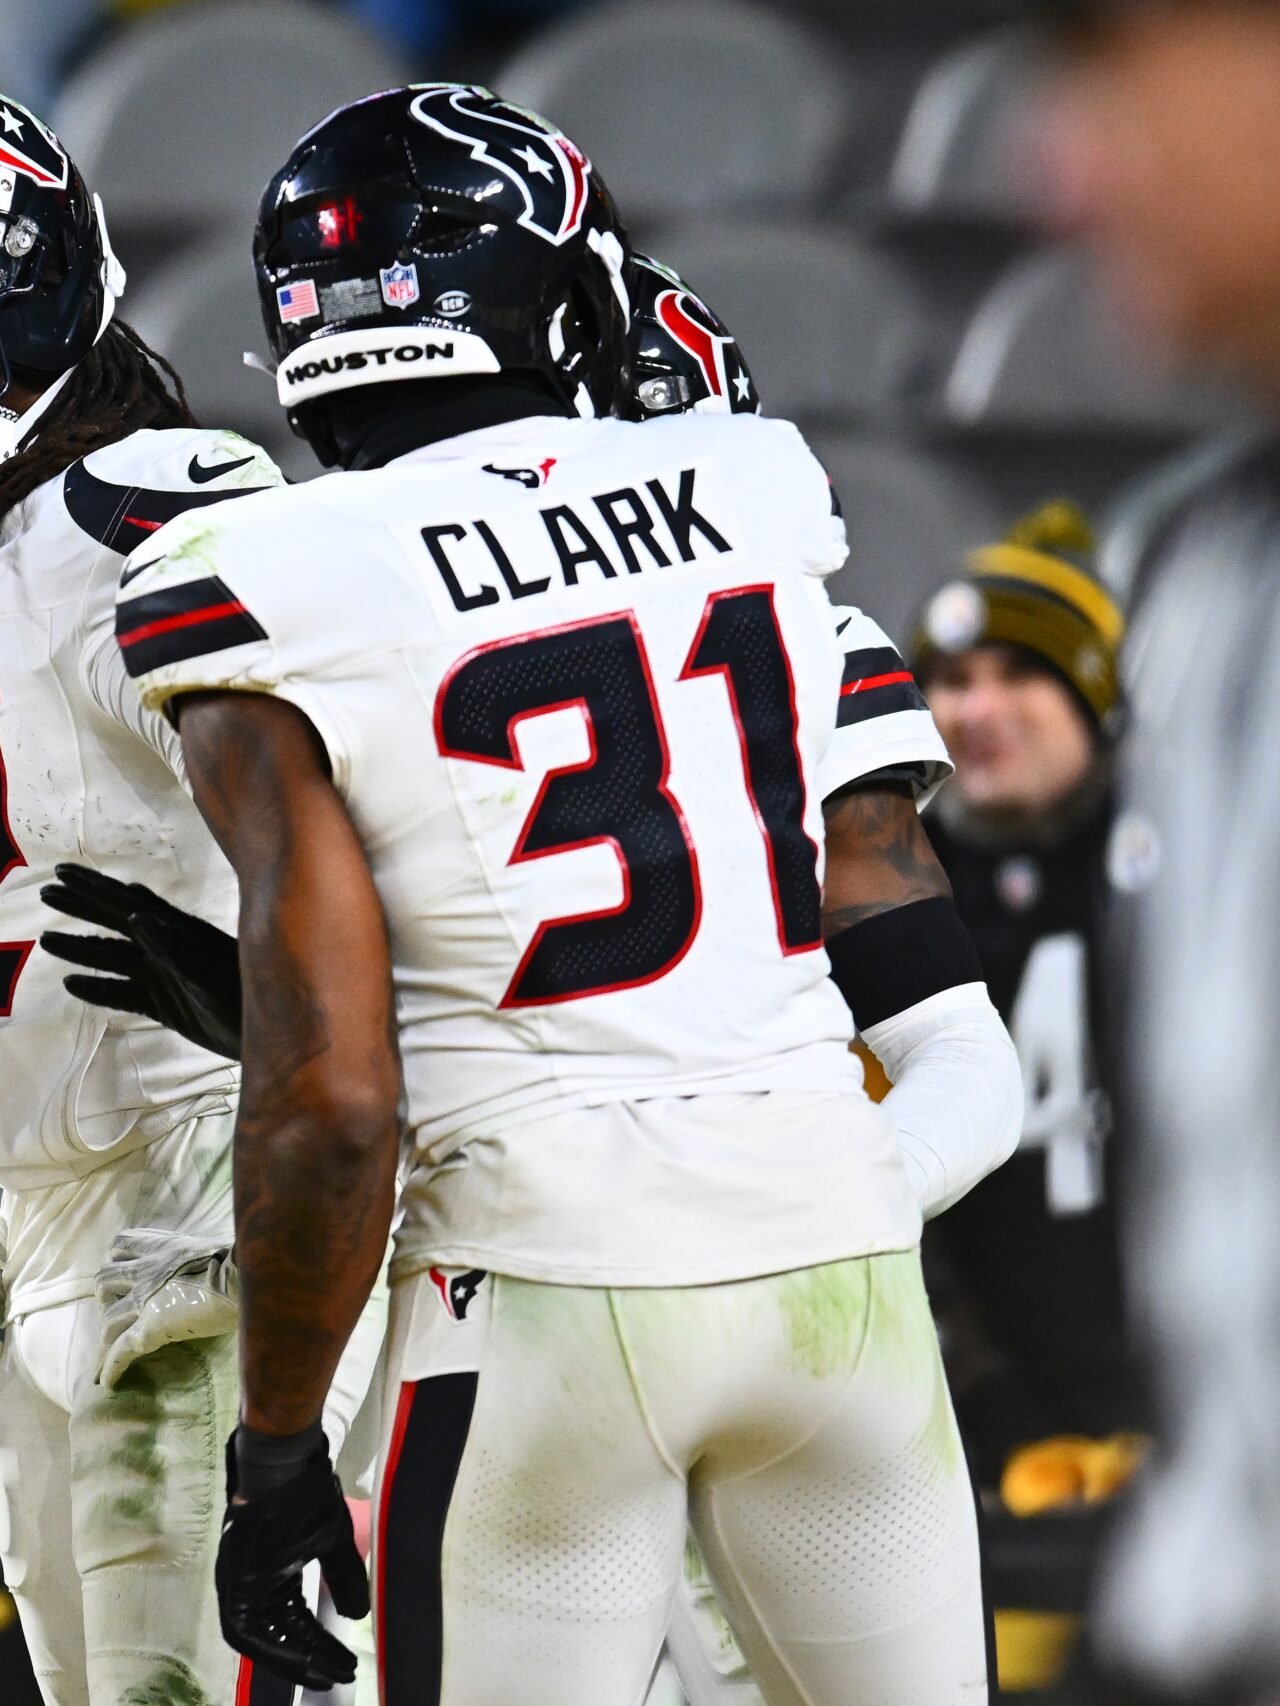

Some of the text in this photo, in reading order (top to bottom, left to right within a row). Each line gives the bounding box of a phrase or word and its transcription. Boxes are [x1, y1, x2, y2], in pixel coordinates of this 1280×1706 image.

[387, 281, 414, 300] NFL
[286, 343, 454, 386] HOUSTON
[421, 468, 733, 613] CLARK
[432, 582, 824, 1011] 31
